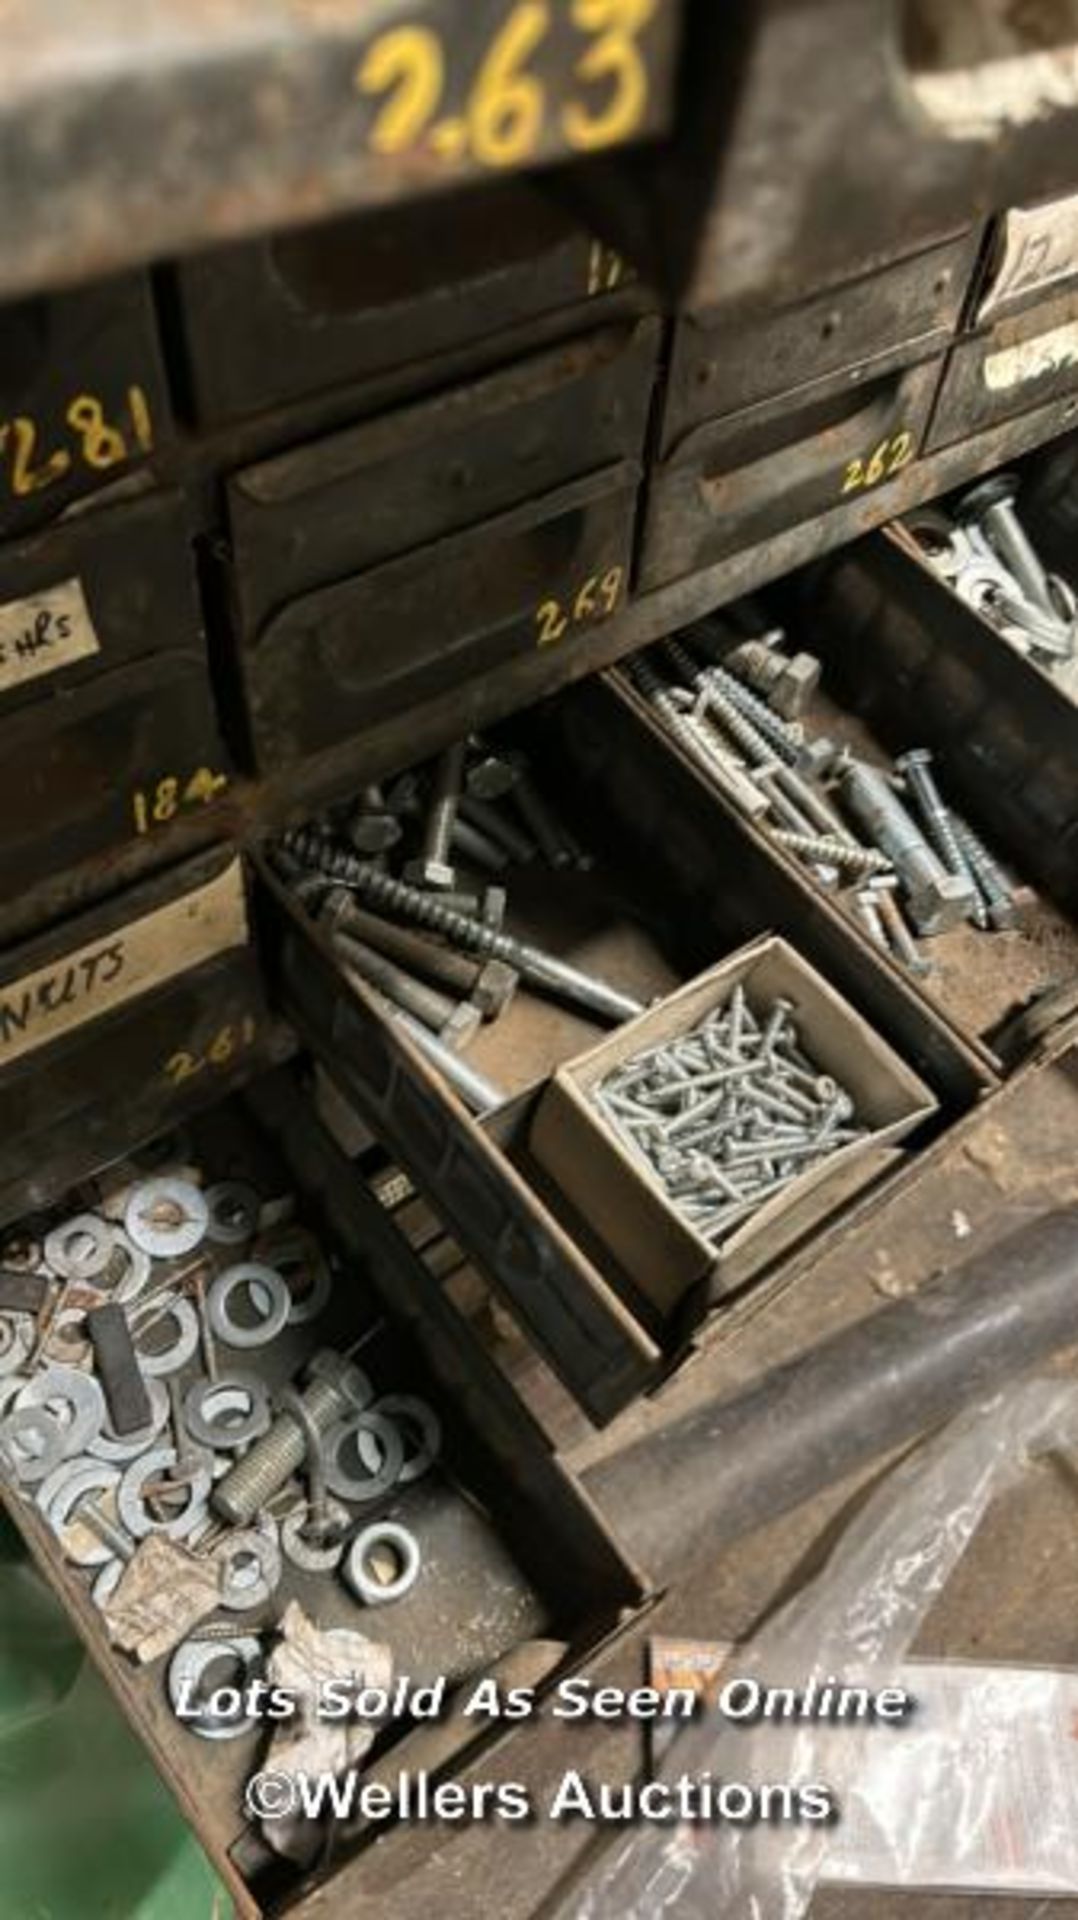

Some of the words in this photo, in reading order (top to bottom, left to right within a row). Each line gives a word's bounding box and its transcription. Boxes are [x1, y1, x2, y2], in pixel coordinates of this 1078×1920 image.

[357, 0, 650, 167] 263
[0, 383, 152, 494] 281
[840, 432, 914, 493] 262
